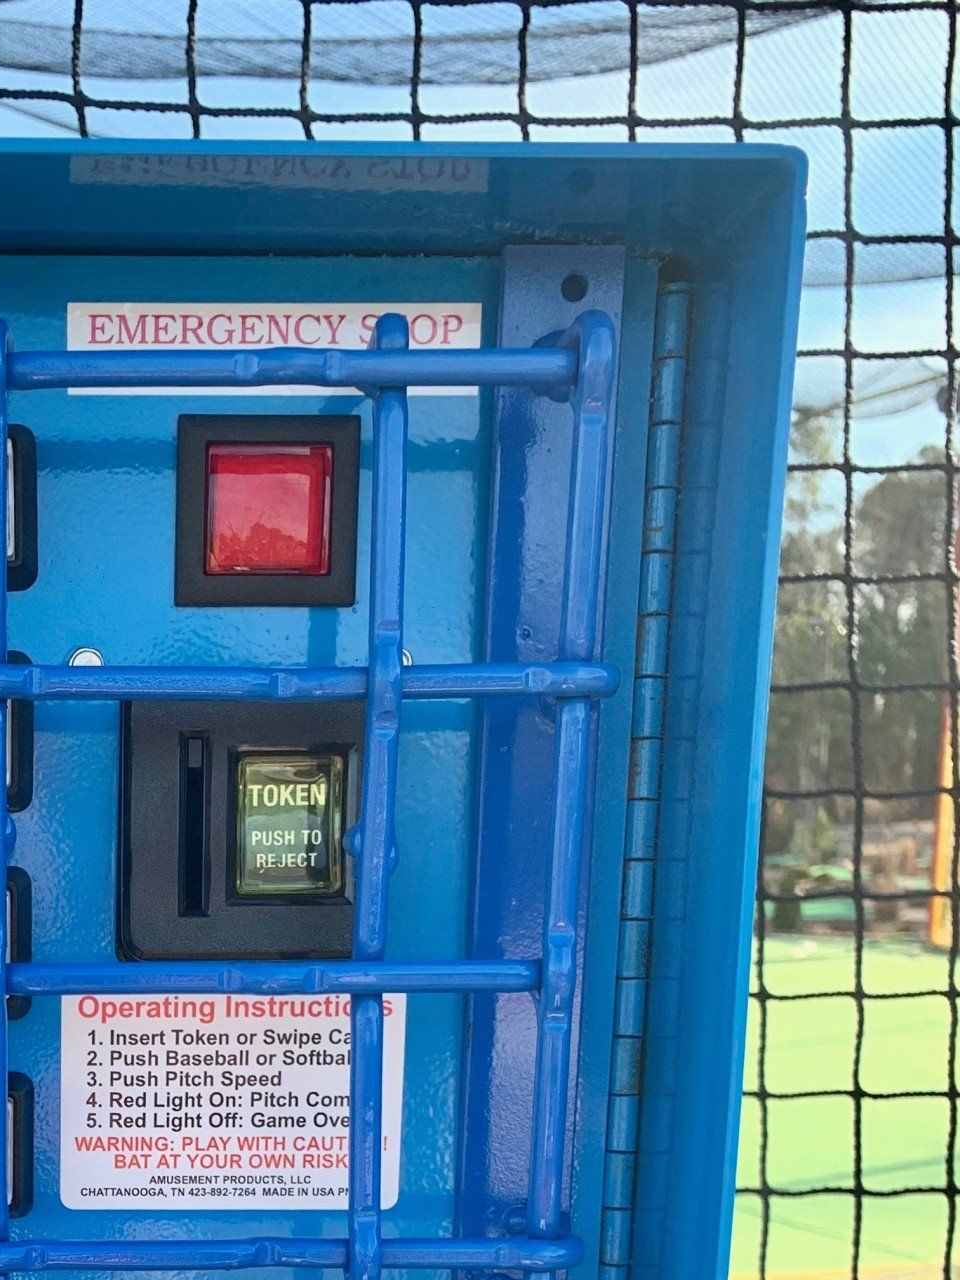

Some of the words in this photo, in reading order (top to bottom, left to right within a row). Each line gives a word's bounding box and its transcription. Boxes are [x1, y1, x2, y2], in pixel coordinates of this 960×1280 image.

[87, 313, 346, 345] EMERGENCY
[359, 313, 463, 345] SOP
[248, 784, 326, 807] TOKEN
[251, 830, 295, 846] PUSH
[302, 829, 322, 845] TO
[256, 853, 317, 868] REJECT
[78, 995, 216, 1024] Operating
[226, 995, 393, 1018] Instructis
[88, 1029, 103, 1045] 1.
[110, 1029, 166, 1045] Insert
[172, 1029, 229, 1045] Token
[236, 1033, 257, 1045] or
[263, 1029, 322, 1049] Swipe
[329, 1029, 351, 1044] Ca
[86, 1050, 103, 1066] 2.
[110, 1050, 158, 1066] Push
[166, 1050, 249, 1066] Baseball
[256, 1053, 276, 1066] or
[282, 1050, 351, 1066] Softbal
[86, 1071, 103, 1087] 3.
[110, 1071, 158, 1087] Push
[165, 1071, 214, 1087] Pitch
[221, 1070, 282, 1091] Speed
[86, 1092, 102, 1108] 4.
[109, 1092, 146, 1108] Red
[154, 1092, 202, 1112] Light
[209, 1092, 242, 1108] On:
[251, 1091, 299, 1107] Pitch
[86, 1113, 102, 1128] 5.
[109, 1113, 146, 1128] Red
[154, 1113, 202, 1132] Light
[208, 1113, 243, 1128] Off:
[251, 1112, 306, 1128] Game
[313, 1112, 350, 1128] Ove
[75, 1136, 174, 1152] WARNING:
[182, 1136, 231, 1151] PLAY
[237, 1136, 286, 1151] WITH
[114, 1154, 152, 1169] BAT
[157, 1154, 181, 1169] AT
[186, 1153, 242, 1169] YOUR
[248, 1153, 295, 1169] OWN
[303, 1153, 348, 1168] RISK
[149, 1175, 220, 1185] AMUSEMENT
[223, 1175, 287, 1186] PRODUCTS,
[291, 1175, 311, 1184] LLC
[80, 1187, 167, 1198] CHATTANOOGA,
[171, 1187, 185, 1197] TN
[188, 1187, 256, 1197] 423-892-7264
[262, 1187, 294, 1197] MADE
[297, 1187, 308, 1196] IN
[312, 1187, 335, 1196] USA
